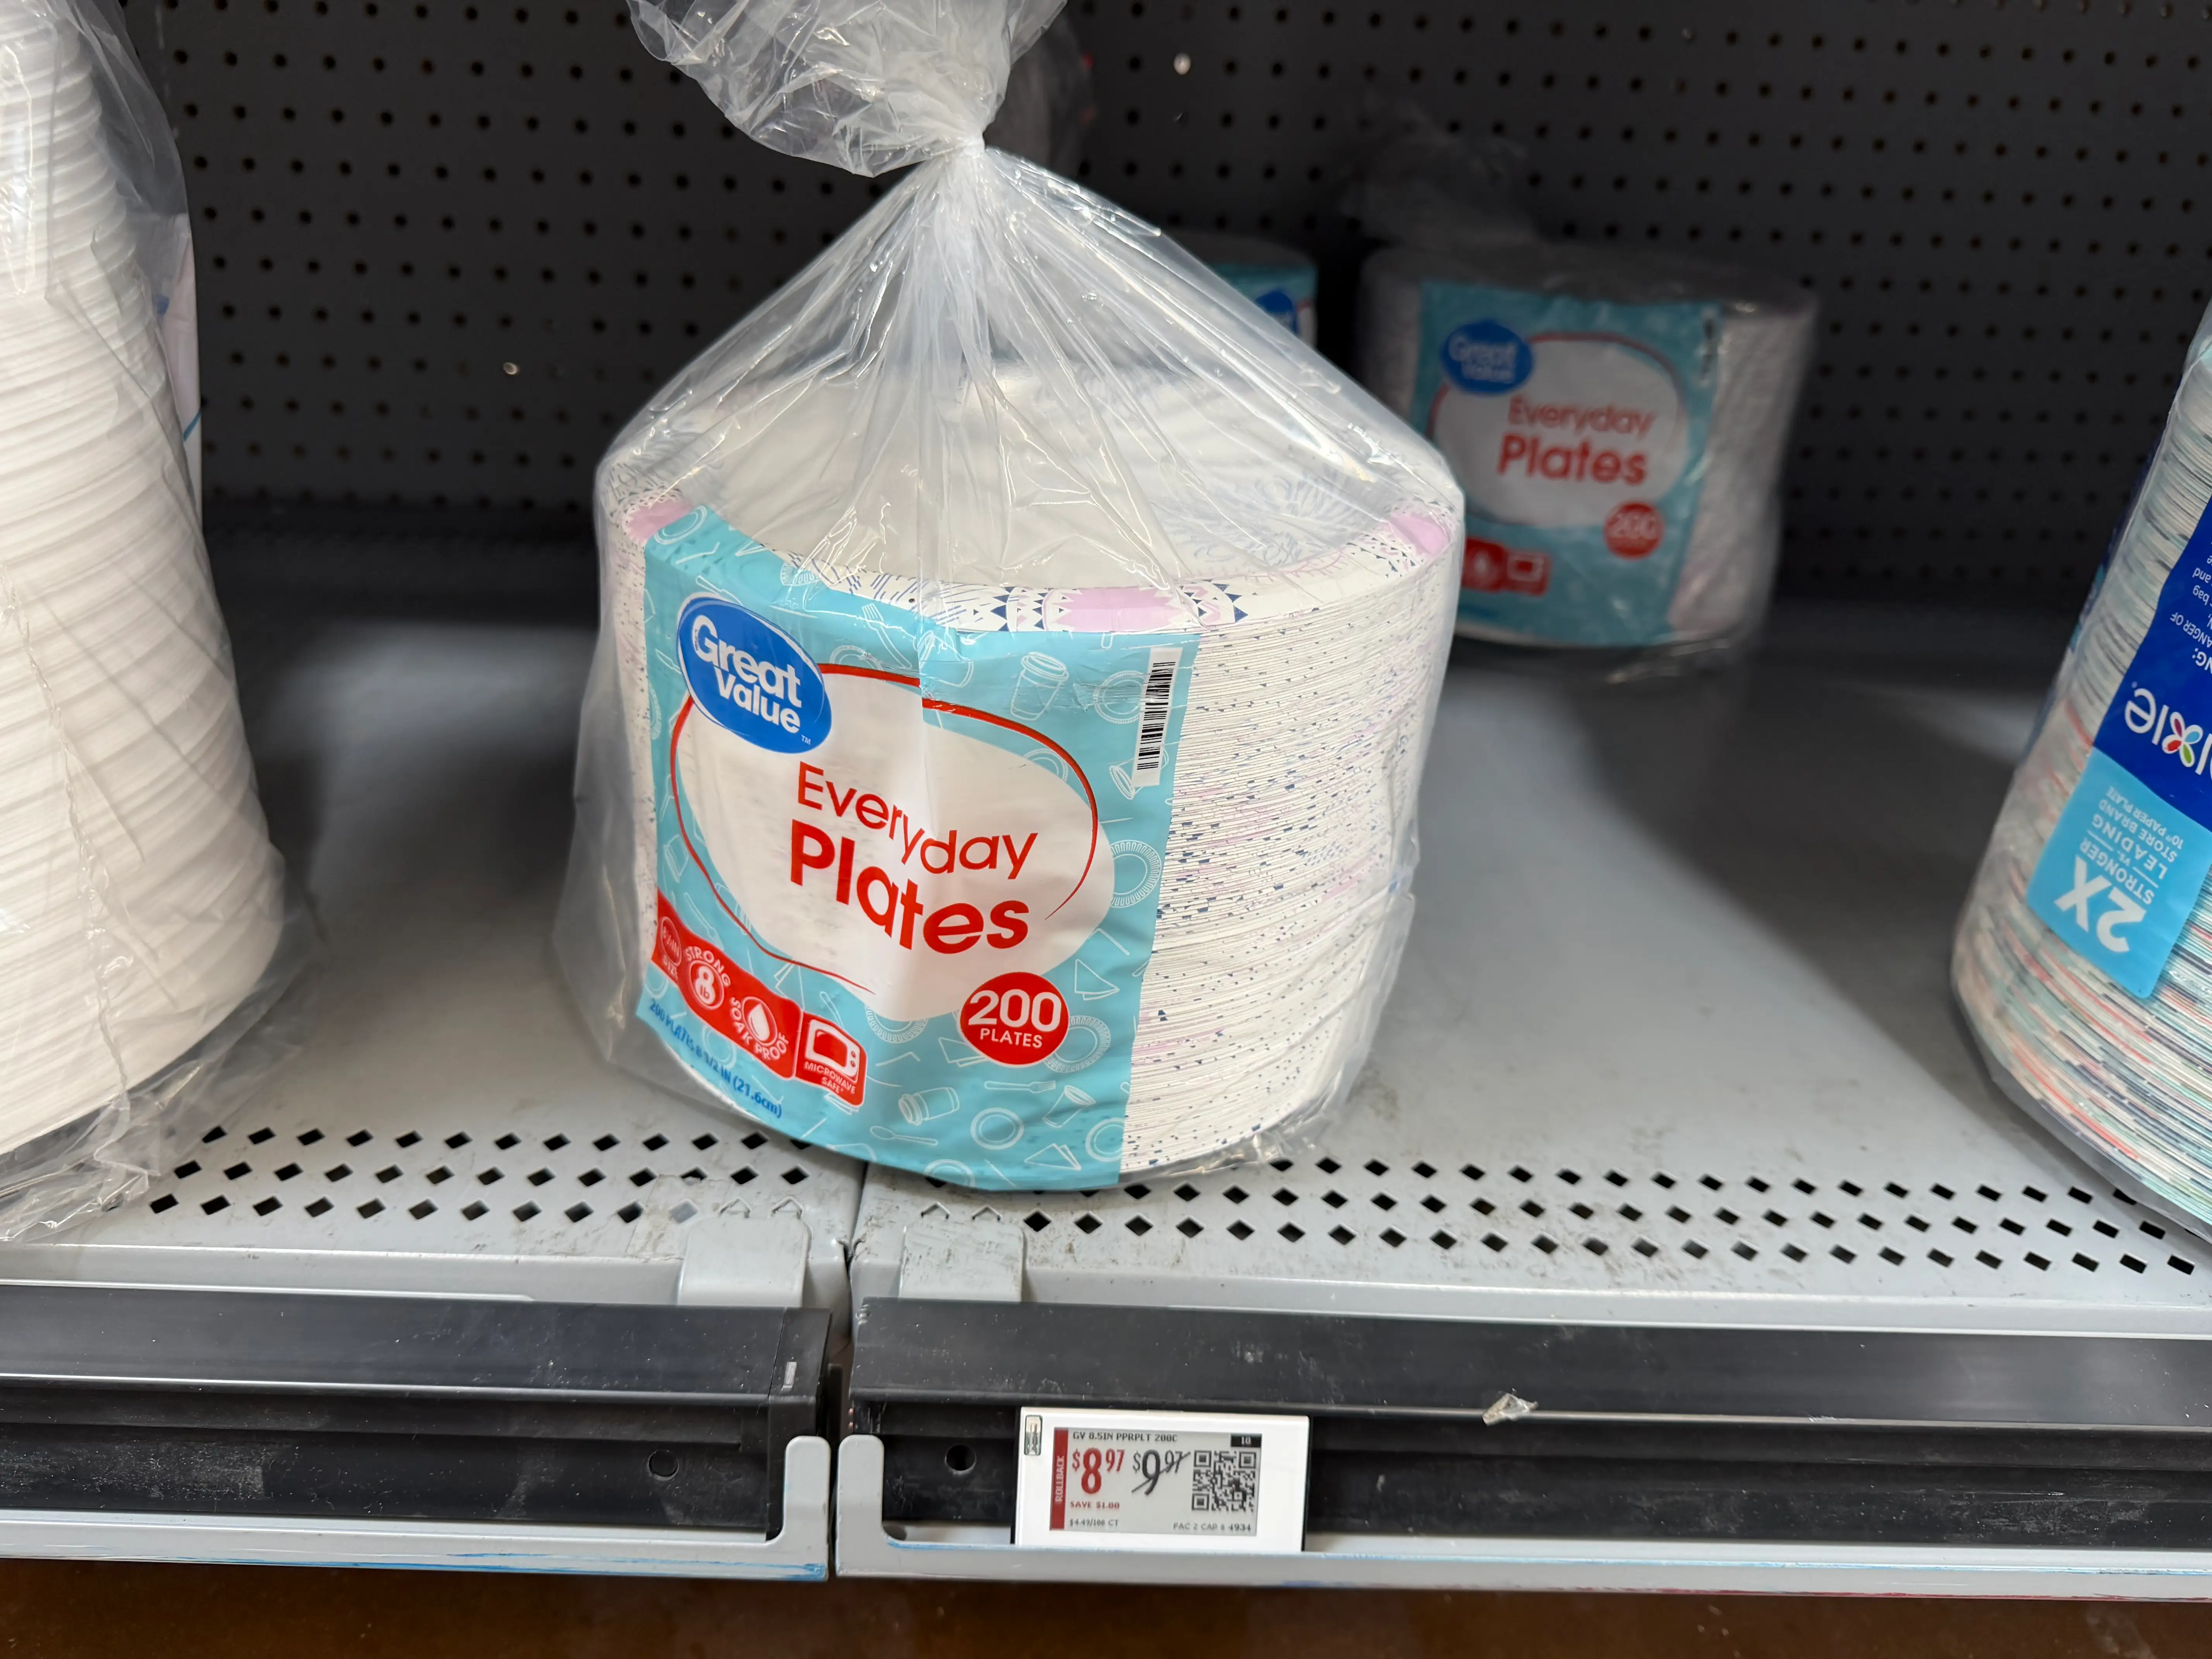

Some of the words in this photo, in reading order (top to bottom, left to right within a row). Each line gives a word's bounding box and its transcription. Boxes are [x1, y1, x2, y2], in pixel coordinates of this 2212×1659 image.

[1508, 394, 1657, 441] Everyday
[1497, 432, 1648, 485] Plates
[2192, 567, 2212, 583] and
[2192, 585, 2210, 605] bag
[2169, 612, 2184, 626] OF
[2183, 620, 2212, 648] ANGER
[692, 614, 802, 708] Great
[713, 667, 800, 733] Value
[798, 761, 1038, 879] Everyday
[2098, 799, 2138, 834] BRAND
[2133, 808, 2167, 836] PAPER
[2092, 814, 2168, 880] LEADING
[2138, 828, 2178, 863] STORE
[791, 819, 1029, 954] Plates
[2079, 838, 2155, 905] STRONGER
[2054, 855, 2147, 953] 2X
[685, 946, 731, 987] STRONG
[695, 965, 716, 1005] 8
[700, 985, 710, 999] lb
[969, 989, 1061, 1032] 200
[729, 997, 753, 1045] SOAK
[755, 1032, 789, 1060] PROOF
[980, 1028, 1042, 1048] PLATES
[649, 998, 665, 1022] 200
[666, 1017, 694, 1051] PLATES
[721, 1066, 732, 1083] IN
[733, 1075, 782, 1118] (21.6cm)
[804, 1061, 856, 1094] MICROWAVE
[1073, 1432, 1085, 1440] GV
[1089, 1432, 1113, 1440] 8.5IN
[1116, 1433, 1151, 1441] PPRPLT
[1154, 1434, 1178, 1442] 200C
[1055, 1455, 1065, 1502] ROLLBACK
